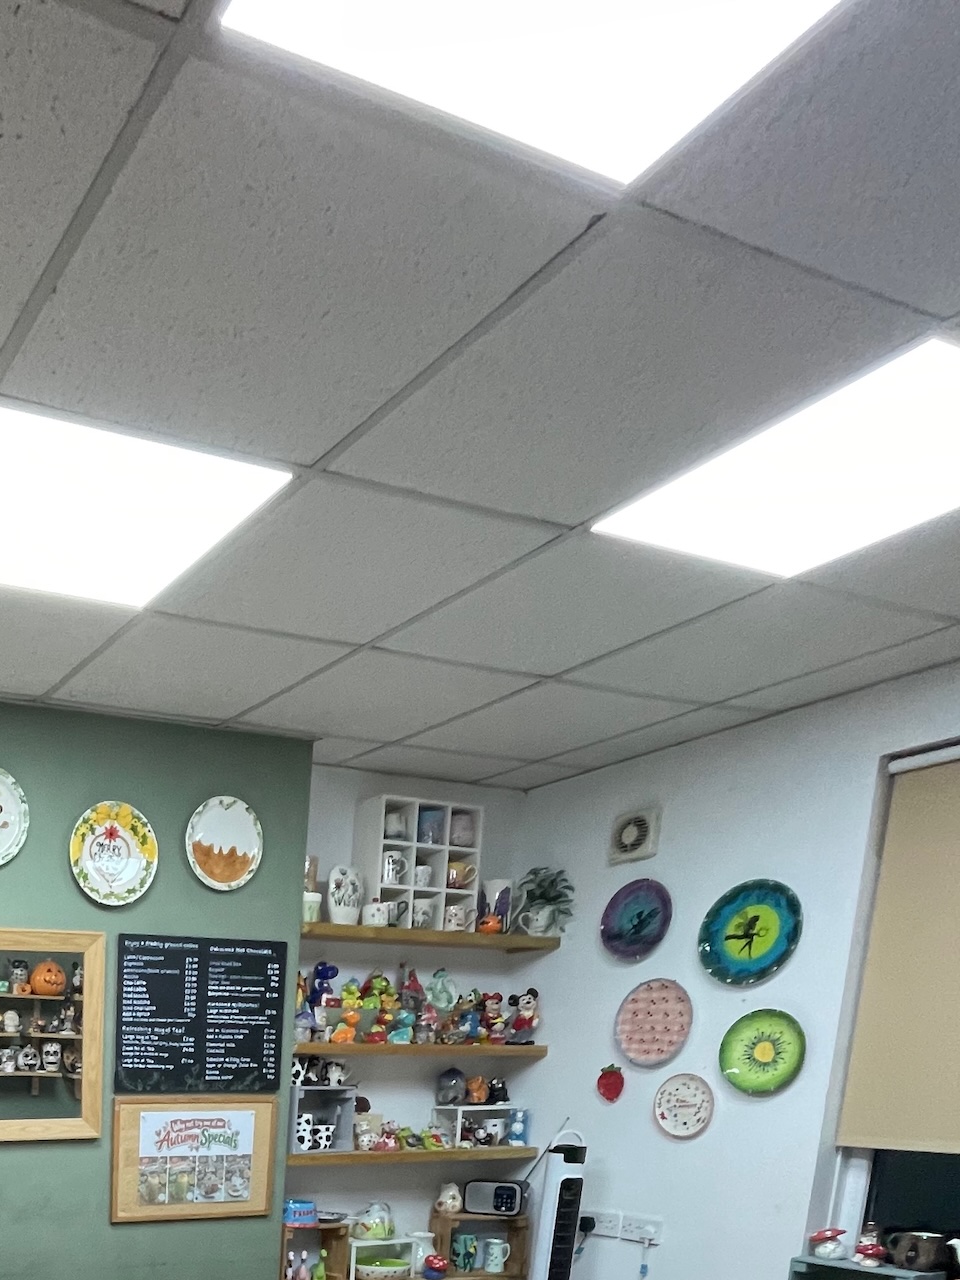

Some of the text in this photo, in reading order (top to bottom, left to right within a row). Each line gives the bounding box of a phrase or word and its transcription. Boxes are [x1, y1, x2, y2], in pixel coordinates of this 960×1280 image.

[122, 1025, 151, 1034] Refreshing
[172, 1122, 185, 1132] Why
[156, 1128, 237, 1150] Autumn Specials
